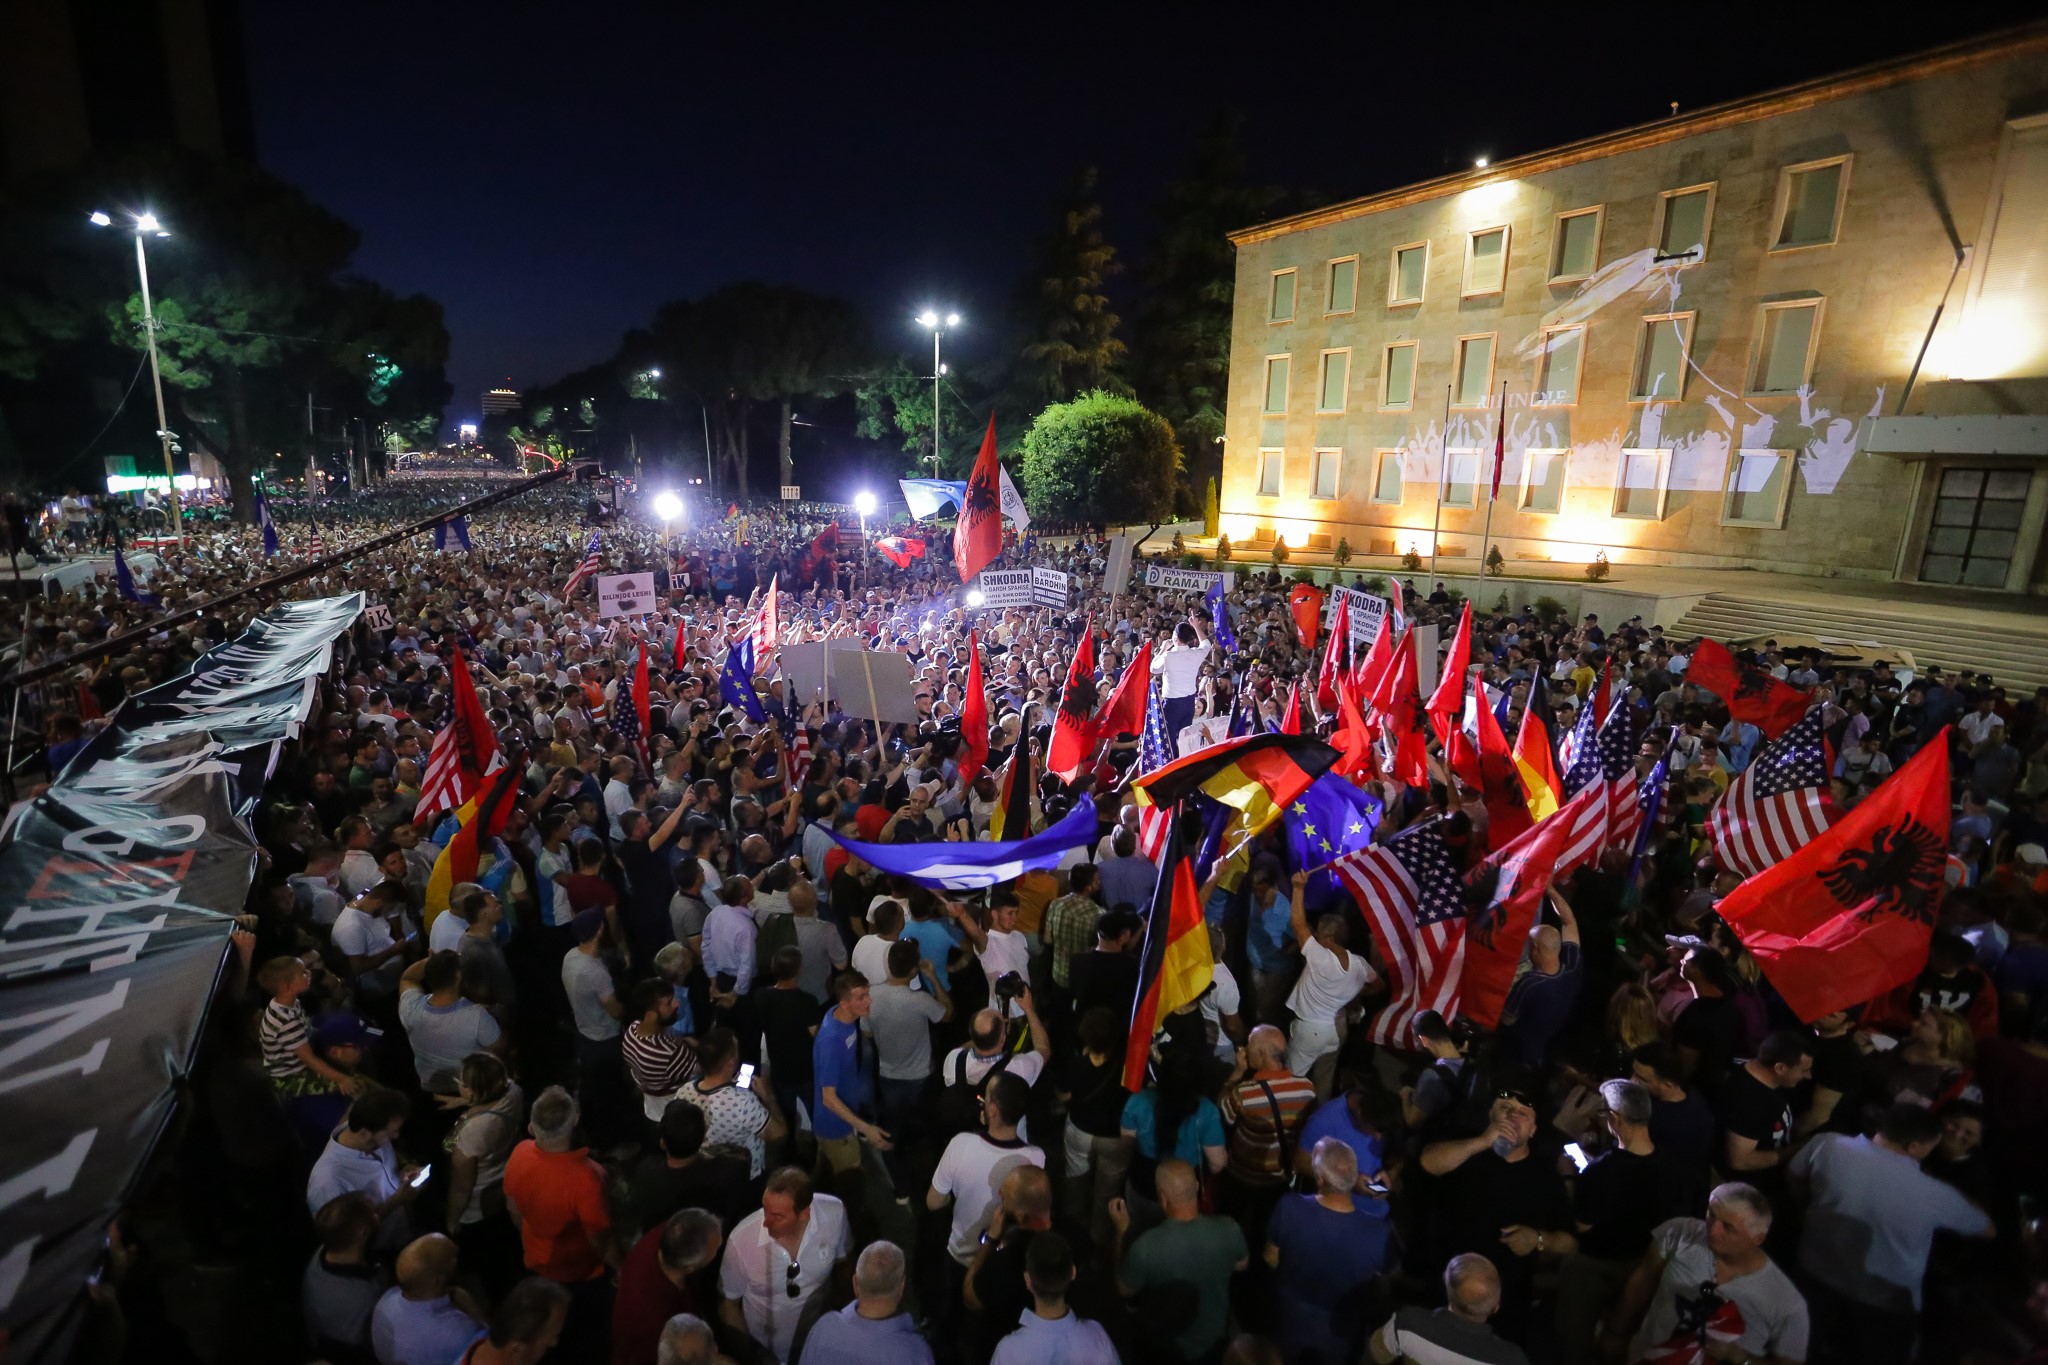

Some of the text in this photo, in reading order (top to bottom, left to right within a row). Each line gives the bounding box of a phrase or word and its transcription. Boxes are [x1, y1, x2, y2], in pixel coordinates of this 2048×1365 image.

[671, 575, 687, 589] iK
[983, 573, 1030, 586] SHKODRA
[1034, 576, 1067, 591] BARDHIN
[1163, 576, 1200, 589] RAMA
[368, 609, 393, 628] iK
